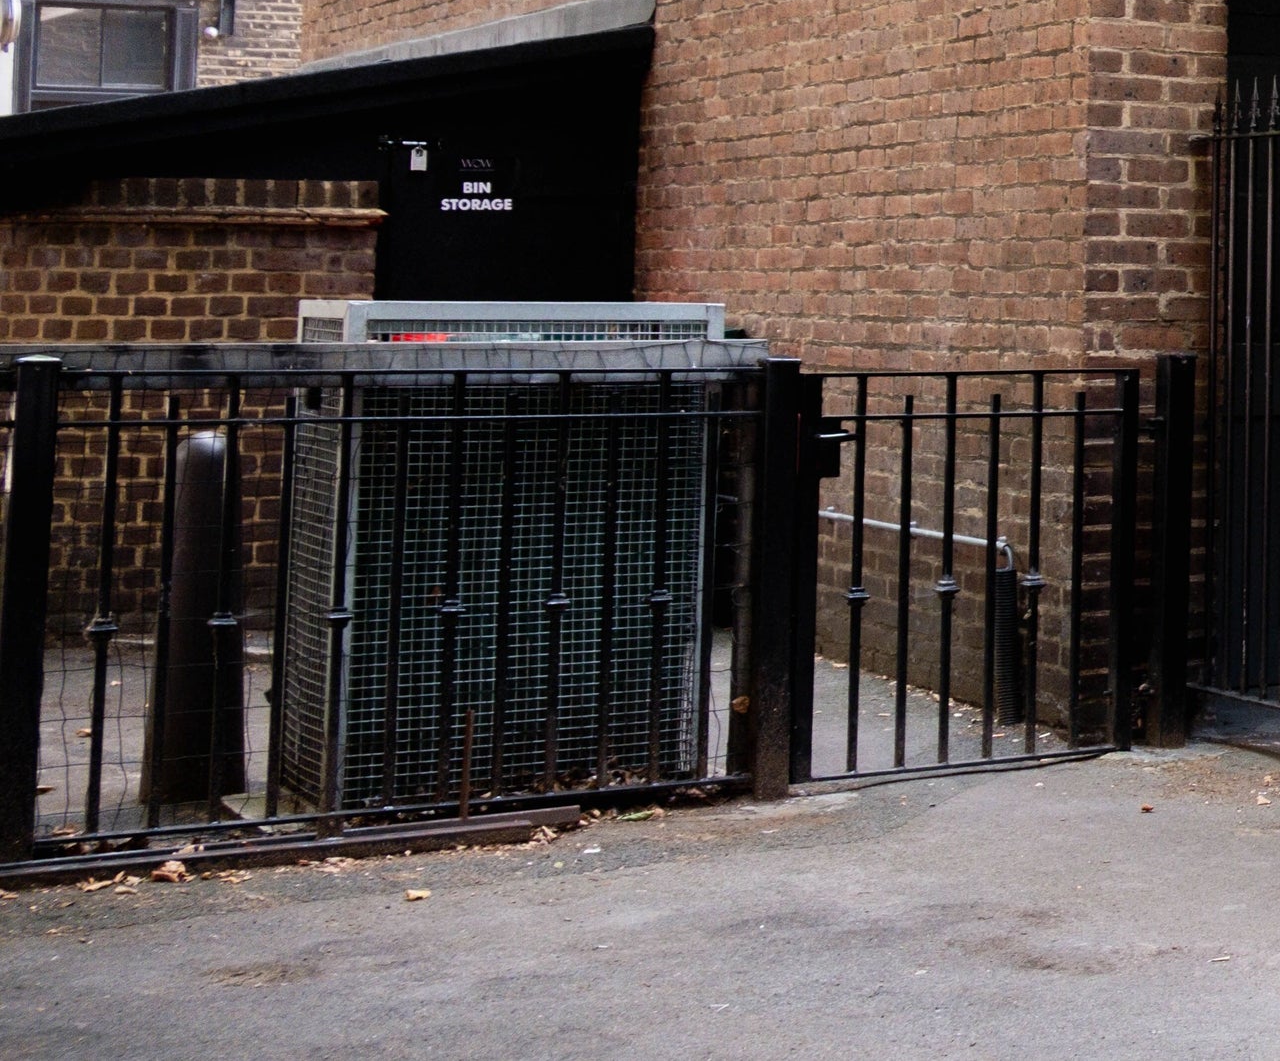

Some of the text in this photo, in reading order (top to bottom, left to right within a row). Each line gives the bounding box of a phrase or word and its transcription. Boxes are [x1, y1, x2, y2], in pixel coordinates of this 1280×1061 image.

[460, 158, 495, 168] WOW
[463, 181, 492, 194] BIN
[440, 198, 513, 210] STORAGE
